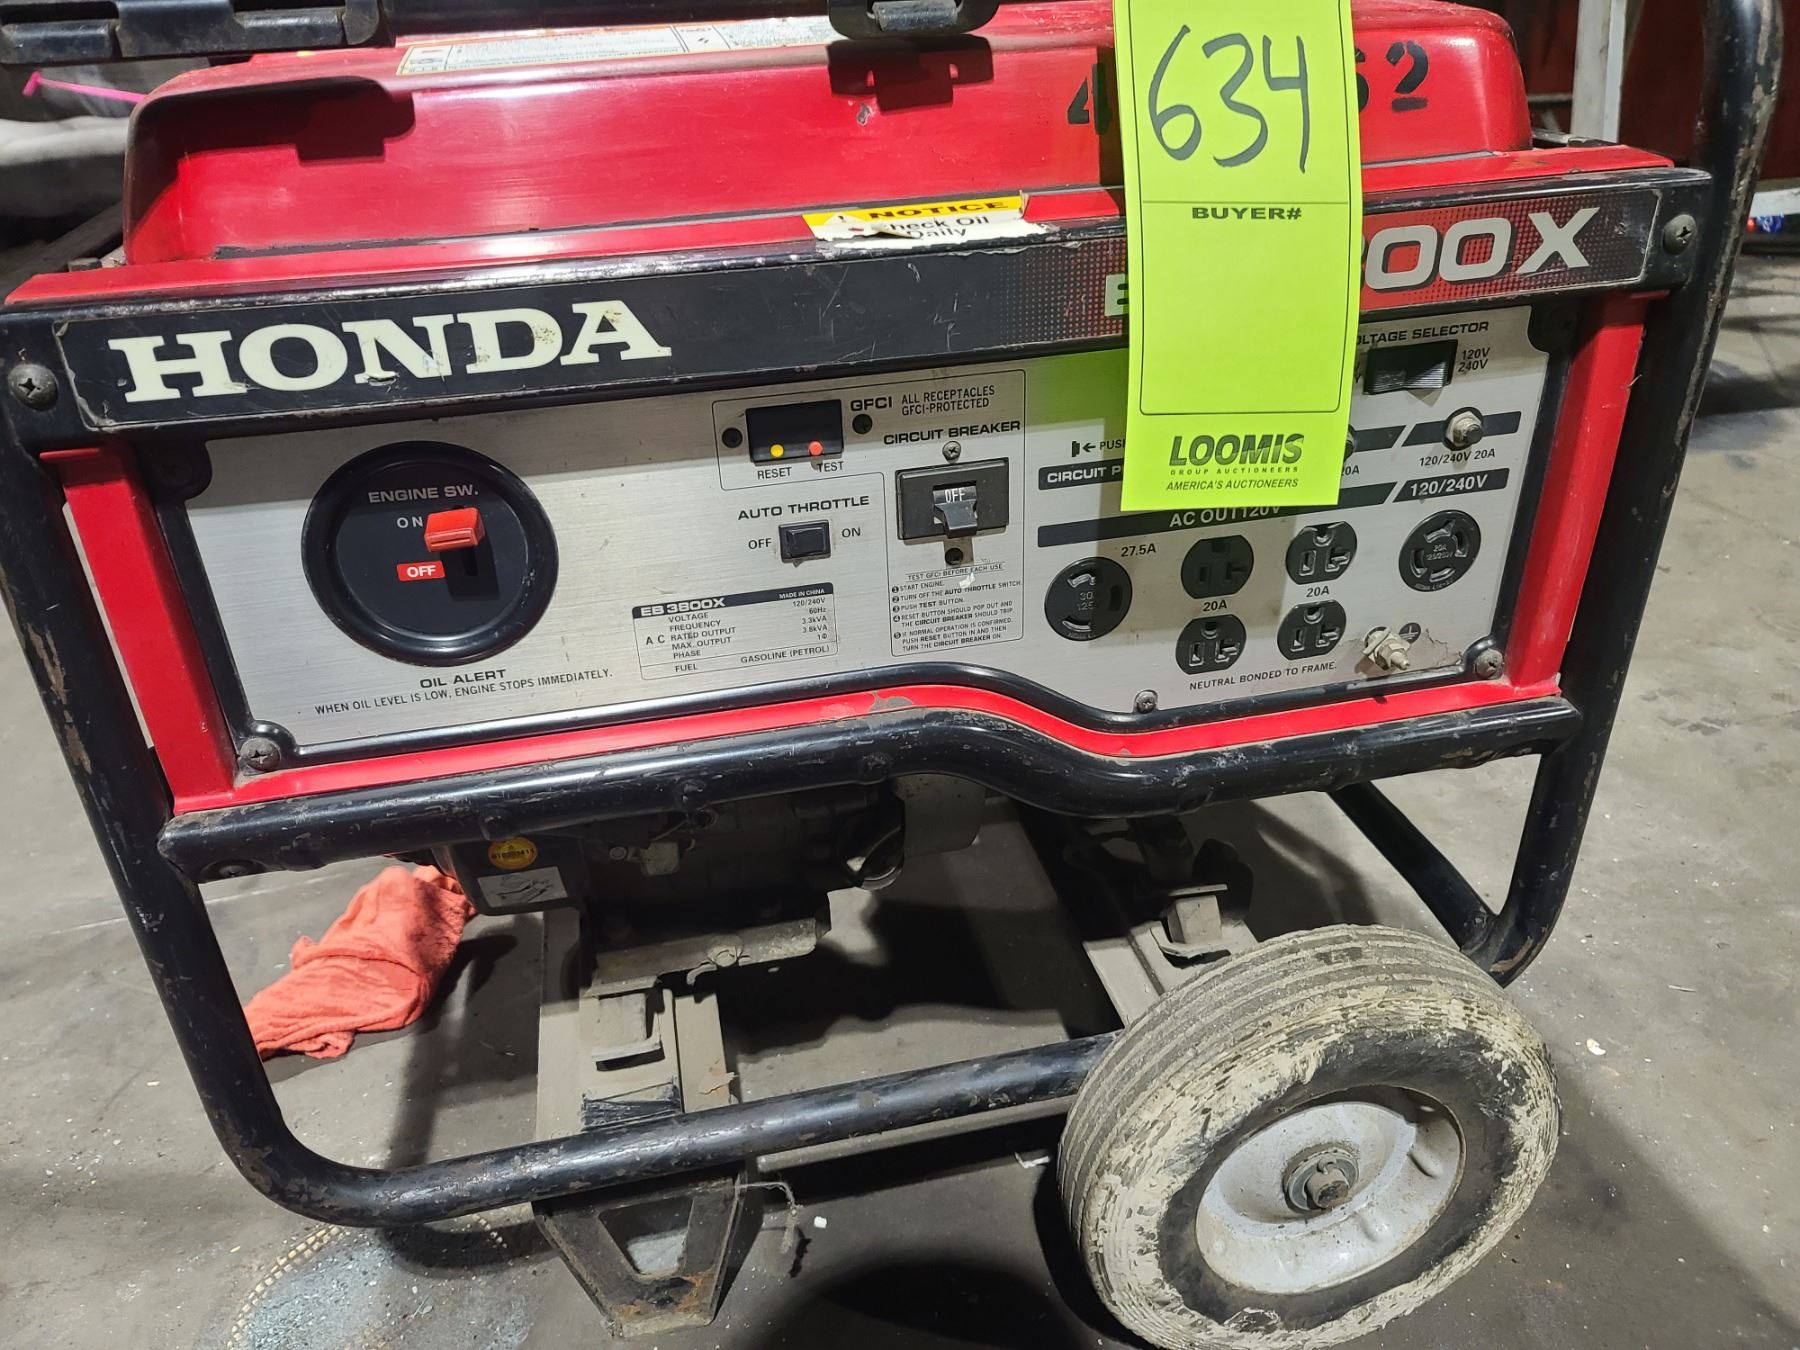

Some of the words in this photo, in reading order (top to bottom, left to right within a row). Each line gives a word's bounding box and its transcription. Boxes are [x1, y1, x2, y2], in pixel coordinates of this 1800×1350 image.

[1149, 24, 1310, 174] 634
[869, 201, 1008, 219] NOTICE
[1192, 207, 1302, 219] BUYER#
[889, 218, 949, 230] heck
[956, 215, 990, 226] Oil
[1362, 207, 1600, 290] 00X
[1357, 330, 1408, 345] LTAGE
[1412, 321, 1489, 339] SELECTOR
[108, 300, 671, 402] HONDA
[1462, 347, 1490, 361] 120V
[1458, 359, 1489, 373] 240V
[901, 393, 921, 405] ALL
[923, 385, 996, 402] RECEPTACLES
[850, 397, 892, 412] GFCI
[901, 397, 990, 416] GFCI-PROTECTED
[884, 428, 945, 445] CIRCUIT
[948, 421, 1021, 438] BREAKER
[1169, 433, 1304, 466] LOOMIS
[1419, 451, 1471, 467] 120/240V
[1474, 448, 1496, 460] 20A
[757, 466, 792, 479] RESET
[817, 461, 844, 473] TEST
[1216, 466, 1298, 474] AUCTIONEERS
[1341, 465, 1360, 476] 0A
[1047, 466, 1107, 483] CIRCUIT
[1166, 480, 1223, 491] AMERICA'S
[1225, 478, 1299, 489] AUCTIONEERS
[1410, 474, 1489, 497] 120/240V
[368, 487, 439, 503] ENGINE
[444, 484, 479, 497] SW.
[944, 487, 966, 502] OFF
[738, 506, 782, 520] AUTO
[787, 496, 869, 514] THROTTLE
[396, 516, 423, 528] ON
[1169, 511, 1195, 528] AC
[841, 527, 861, 538] ON
[748, 537, 772, 549] OFF
[1121, 543, 1156, 557] 27.5A
[406, 565, 436, 578] OFF
[943, 568, 968, 576] BEFORE
[805, 588, 825, 596] CHINA
[964, 583, 996, 592] THROTTLE
[1306, 586, 1330, 598] 20A
[668, 612, 709, 623] VOLTAGE
[793, 597, 826, 607] 120/240V
[921, 610, 945, 618] BUTTON
[947, 606, 971, 614] SHOULD
[1203, 600, 1227, 612] 20A
[669, 619, 722, 632] FREQUENCY
[809, 607, 826, 615] 60Hz
[915, 618, 940, 626] CIRCUIT
[942, 614, 973, 622] BREAKER
[974, 610, 998, 618] SHOULD
[671, 631, 699, 641] RATED
[701, 627, 736, 638] OUTPUT
[910, 628, 934, 636] NORMAL
[935, 624, 968, 632] OPERATION
[672, 642, 695, 650] MAX.
[697, 637, 732, 647] OUTPUT
[920, 634, 940, 642] RESET
[934, 639, 960, 647] CIRCUIT
[961, 634, 991, 644] BREAKER
[673, 650, 701, 659] PHASE
[675, 664, 698, 672] FUEL
[741, 651, 787, 664] GASOLINE
[789, 645, 830, 657] (PETROL)
[420, 677, 447, 689] OIL
[453, 669, 507, 684] ALERT
[1189, 677, 1236, 691] NEUTRAL
[1239, 670, 1282, 683] BONDED
[1285, 668, 1298, 676] TO
[1301, 662, 1337, 674] FRAME.
[314, 702, 350, 715] WHEN
[352, 699, 371, 710] OIL
[374, 695, 408, 708] LEVEL
[410, 693, 421, 703] IS
[424, 689, 452, 701] LOW,
[455, 683, 496, 697] ENGINE
[499, 678, 535, 691] STOPS
[537, 668, 613, 686] IMMEDIATELY.
